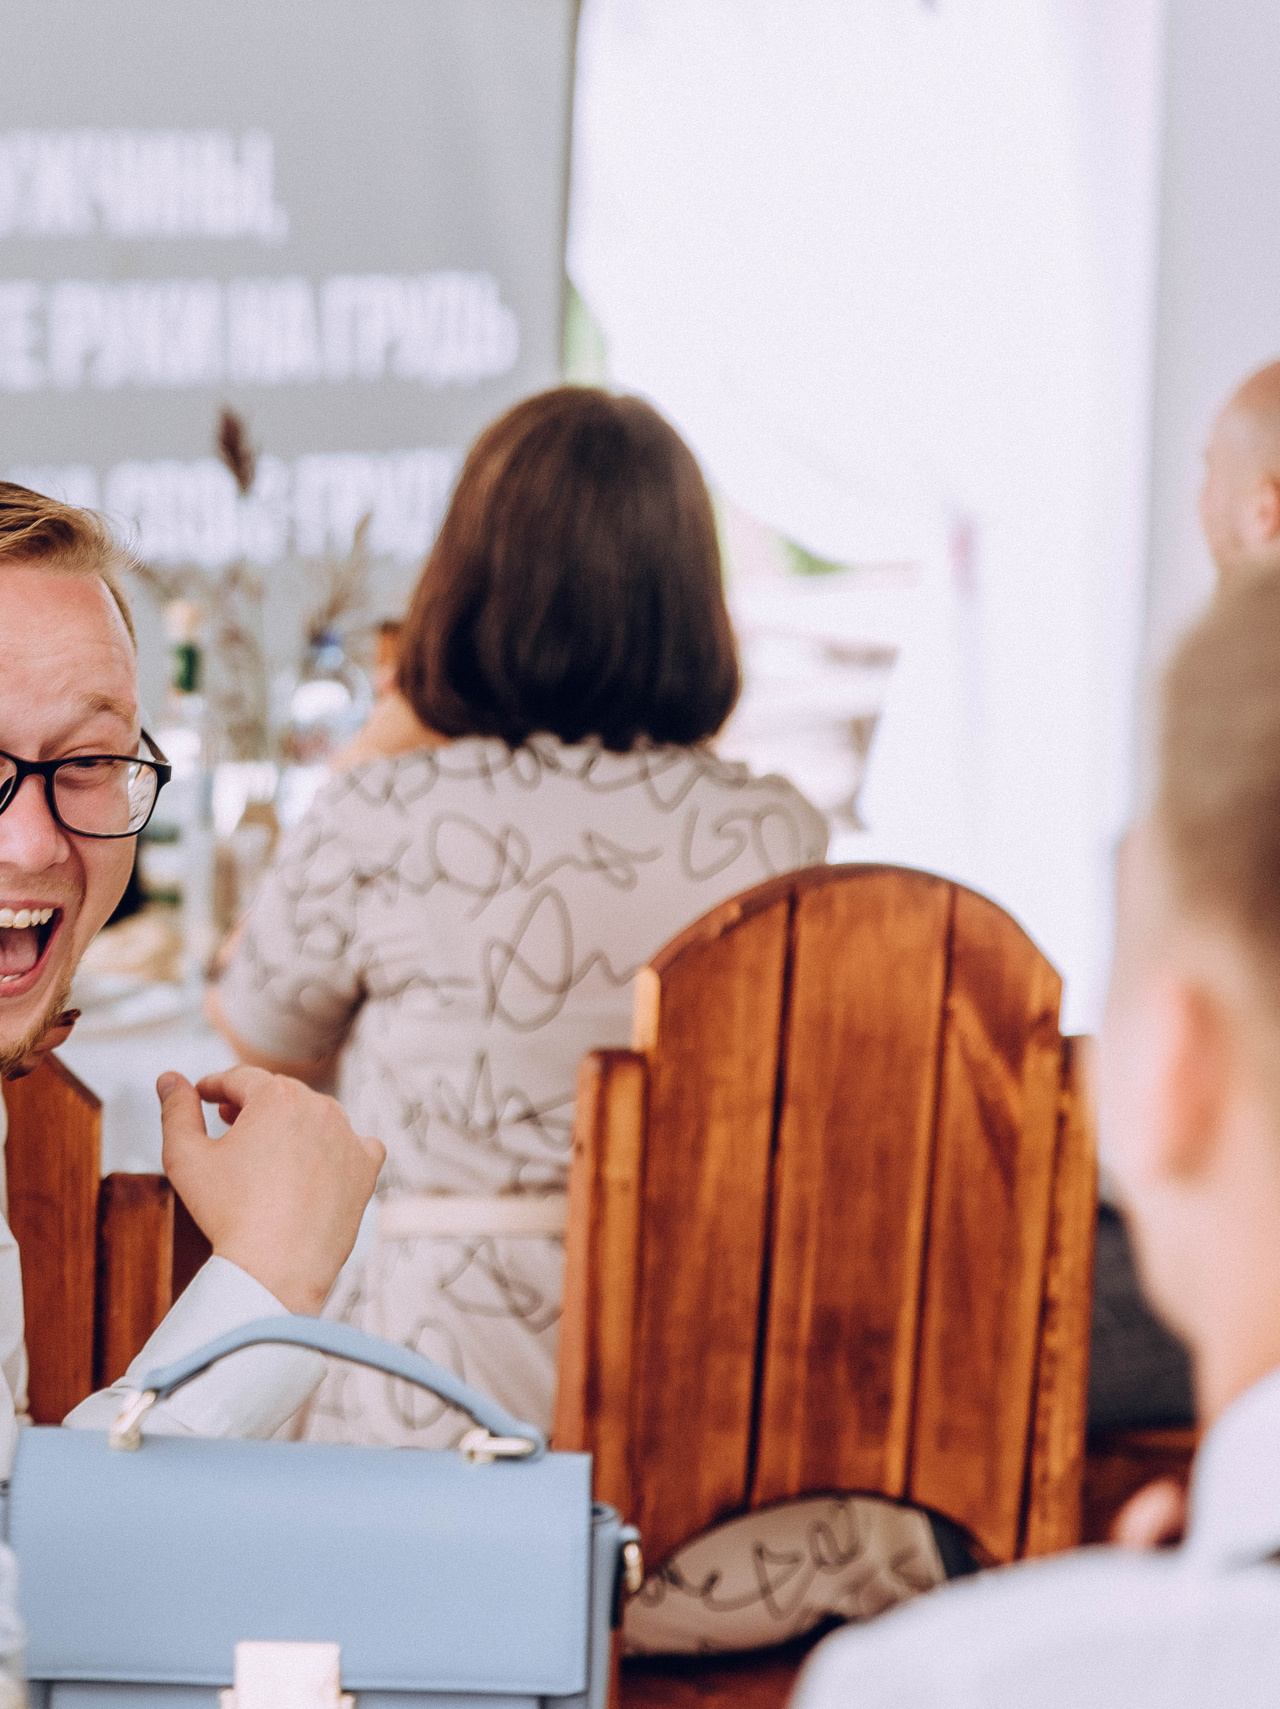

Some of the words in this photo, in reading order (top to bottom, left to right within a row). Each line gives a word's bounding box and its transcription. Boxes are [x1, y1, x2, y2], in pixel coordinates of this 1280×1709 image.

[49, 278, 222, 391] РУКИ
[227, 274, 320, 387] НА
[322, 271, 519, 386] ГРУДЬ
